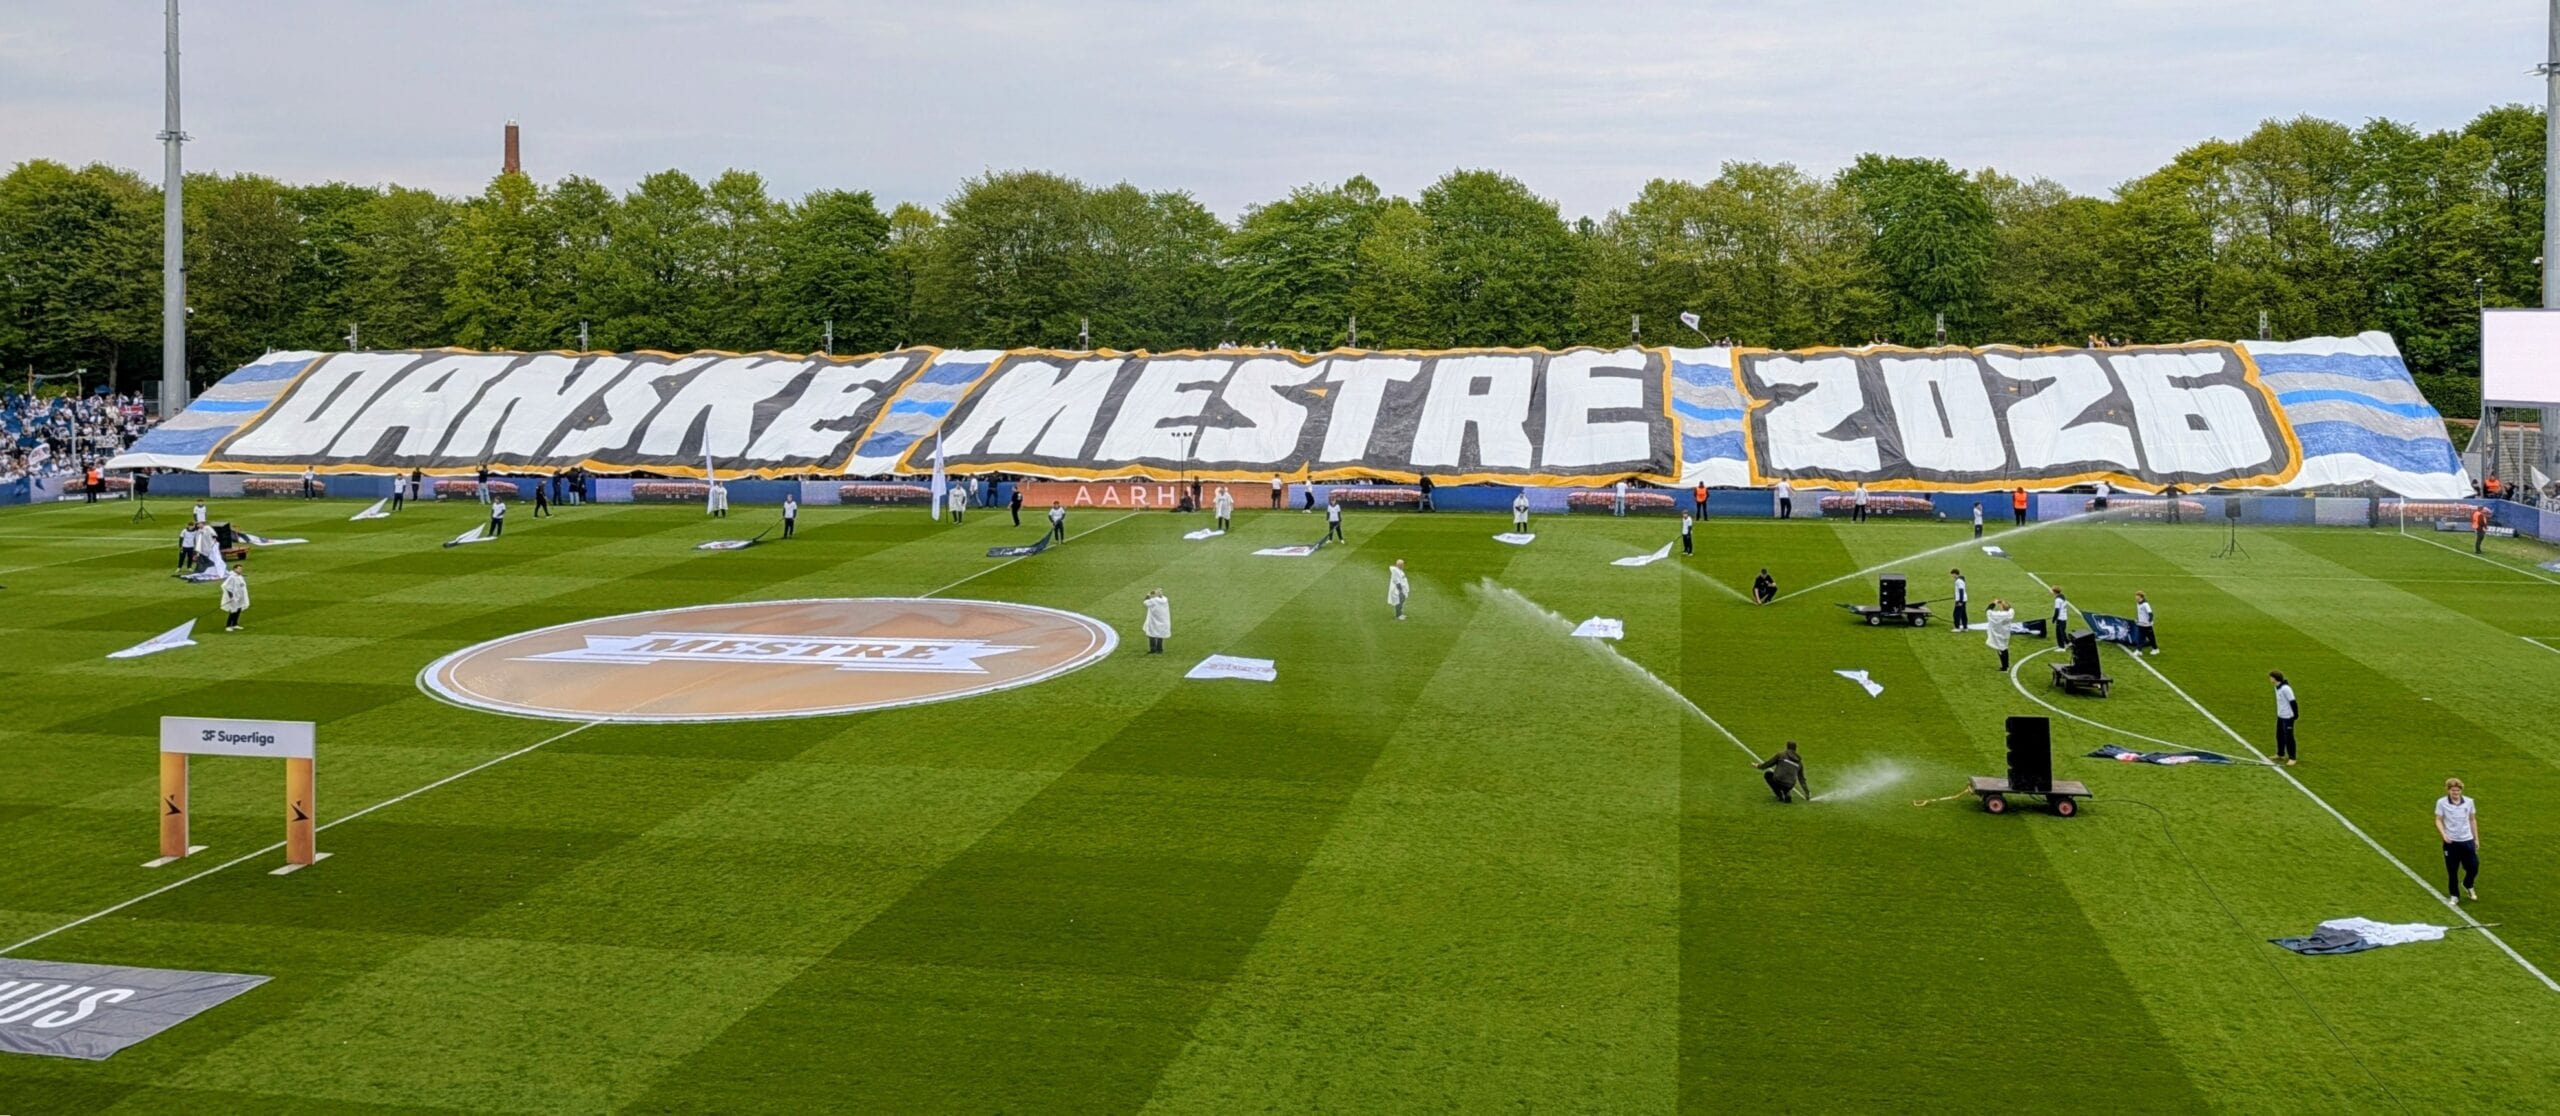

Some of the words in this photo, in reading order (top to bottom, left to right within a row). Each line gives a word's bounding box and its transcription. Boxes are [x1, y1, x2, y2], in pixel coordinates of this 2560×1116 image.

[223, 352, 909, 461] DANSKE
[926, 348, 1650, 467] MESTRE
[1755, 352, 2272, 474] 2026
[623, 638, 951, 660] MESTRE
[202, 730, 216, 741] 3F
[218, 731, 275, 746] Superliga
